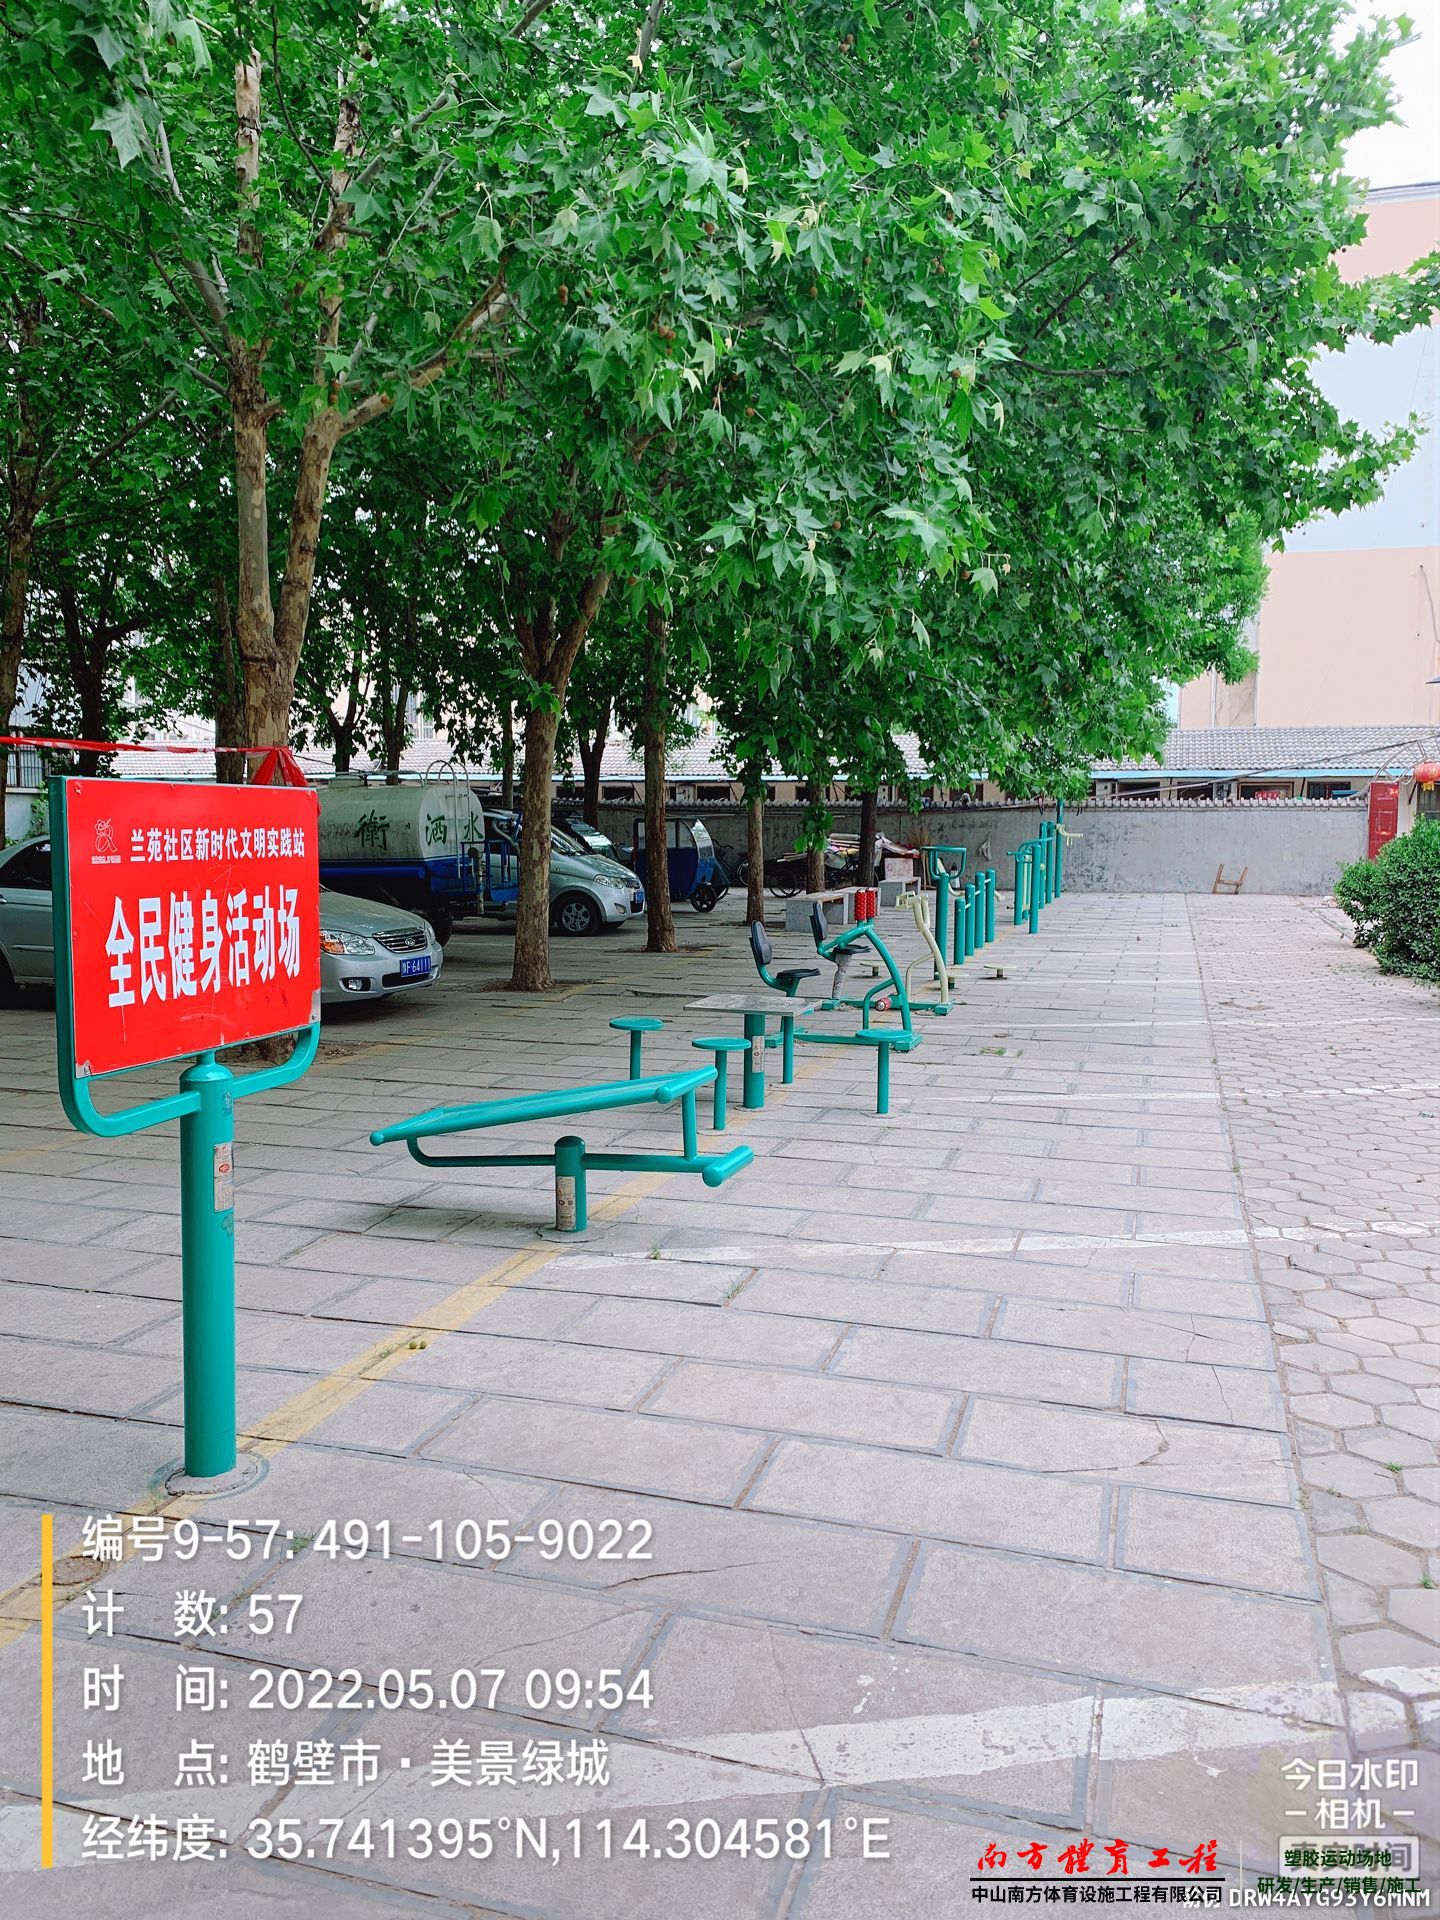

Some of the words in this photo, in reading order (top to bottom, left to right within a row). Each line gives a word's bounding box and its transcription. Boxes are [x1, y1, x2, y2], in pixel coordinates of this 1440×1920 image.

[129, 826, 306, 864] 兰苑社区新时代文明实践站
[104, 884, 301, 1009] 全民健身活动场
